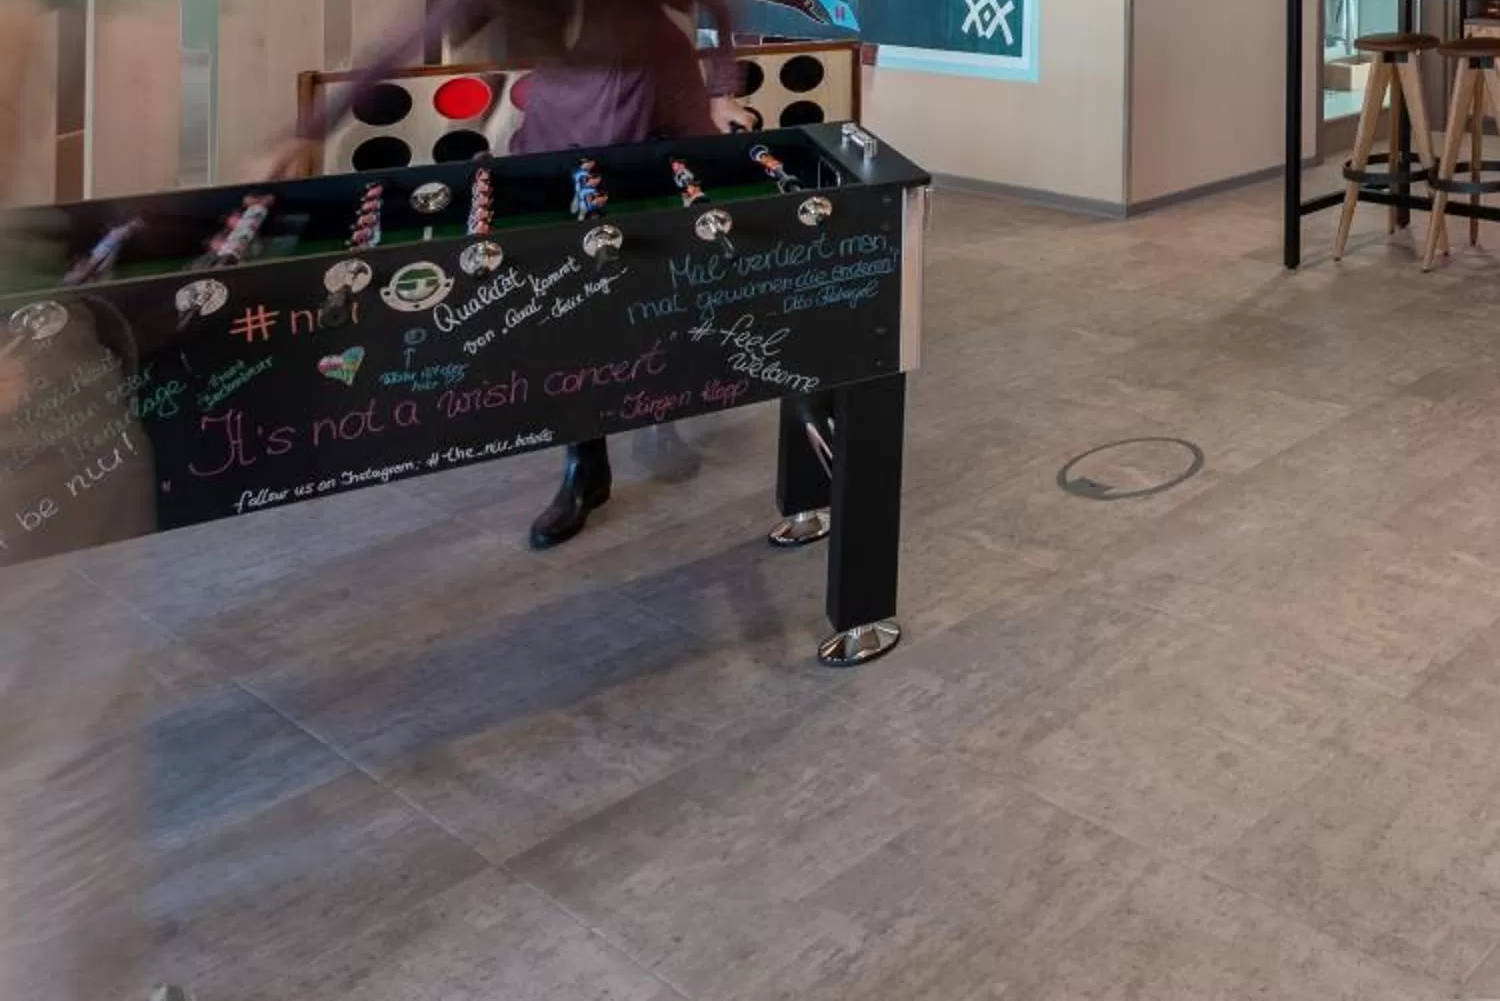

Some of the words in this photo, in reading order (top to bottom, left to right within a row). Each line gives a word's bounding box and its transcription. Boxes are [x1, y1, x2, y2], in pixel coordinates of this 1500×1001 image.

[312, 398, 385, 447] not
[394, 400, 420, 428] a
[436, 370, 530, 420] wish
